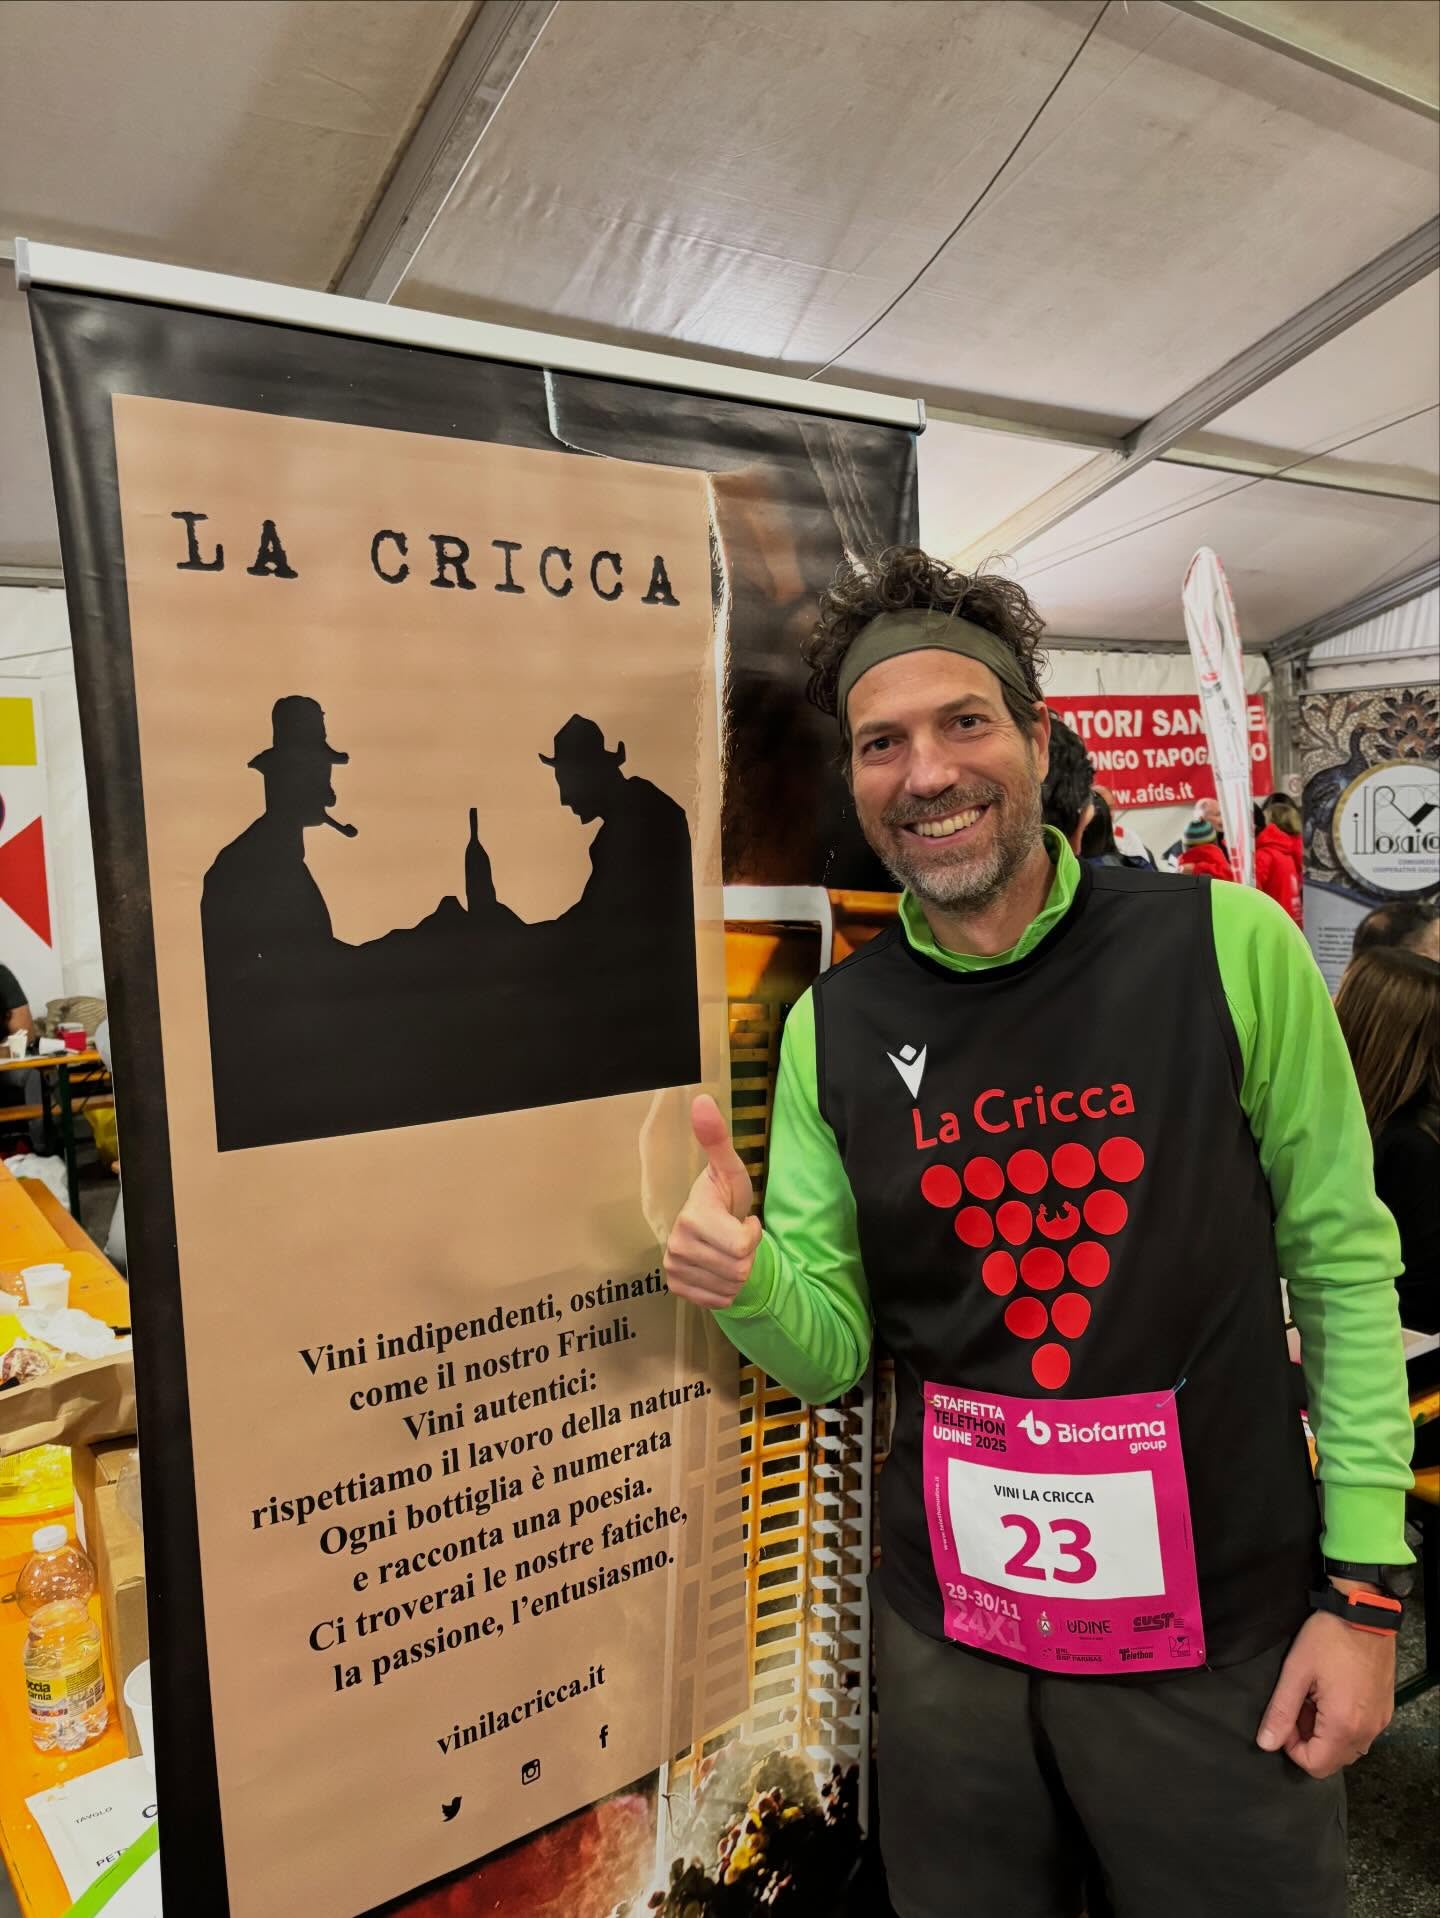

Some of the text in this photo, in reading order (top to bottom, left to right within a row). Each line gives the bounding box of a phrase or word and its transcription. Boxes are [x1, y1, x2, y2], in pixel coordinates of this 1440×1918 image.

[171, 510, 681, 607] LA CRICCA
[1062, 704, 1264, 739] ATORI SANE
[1086, 749, 1139, 770] ONGO
[912, 1083, 1135, 1149] La Cricca
[298, 1268, 668, 1375] Vini indipendenti, ostinati,
[349, 1316, 637, 1411] come il nostro Friuli.
[402, 1368, 597, 1440] Vini autentici:
[932, 1394, 1005, 1421] STAFFETTA
[934, 1409, 1006, 1436] TELETHON
[1055, 1420, 1166, 1443] Biofarma
[251, 1380, 711, 1530] rispettiamo il lavoro della natura.
[932, 1425, 1007, 1453] UDINE 2025
[1129, 1439, 1167, 1454] group
[320, 1430, 672, 1555] Ogni bottiglia è numerata
[993, 1484, 1095, 1504] VINI LA CRICCA
[353, 1477, 652, 1592] e racconta una poesia.
[1000, 1514, 1097, 1584] 23
[309, 1505, 687, 1651] Ci troverai le nostre fatiche,
[945, 1582, 1022, 1621] 29-30/11
[333, 1550, 674, 1692] la passione, l’entusiasmo.
[951, 1600, 1027, 1653] 24X1
[1066, 1619, 1112, 1634] UDINE
[437, 1664, 606, 1755] vinilacricca.it
[75, 1806, 113, 1824] TAVOLO
